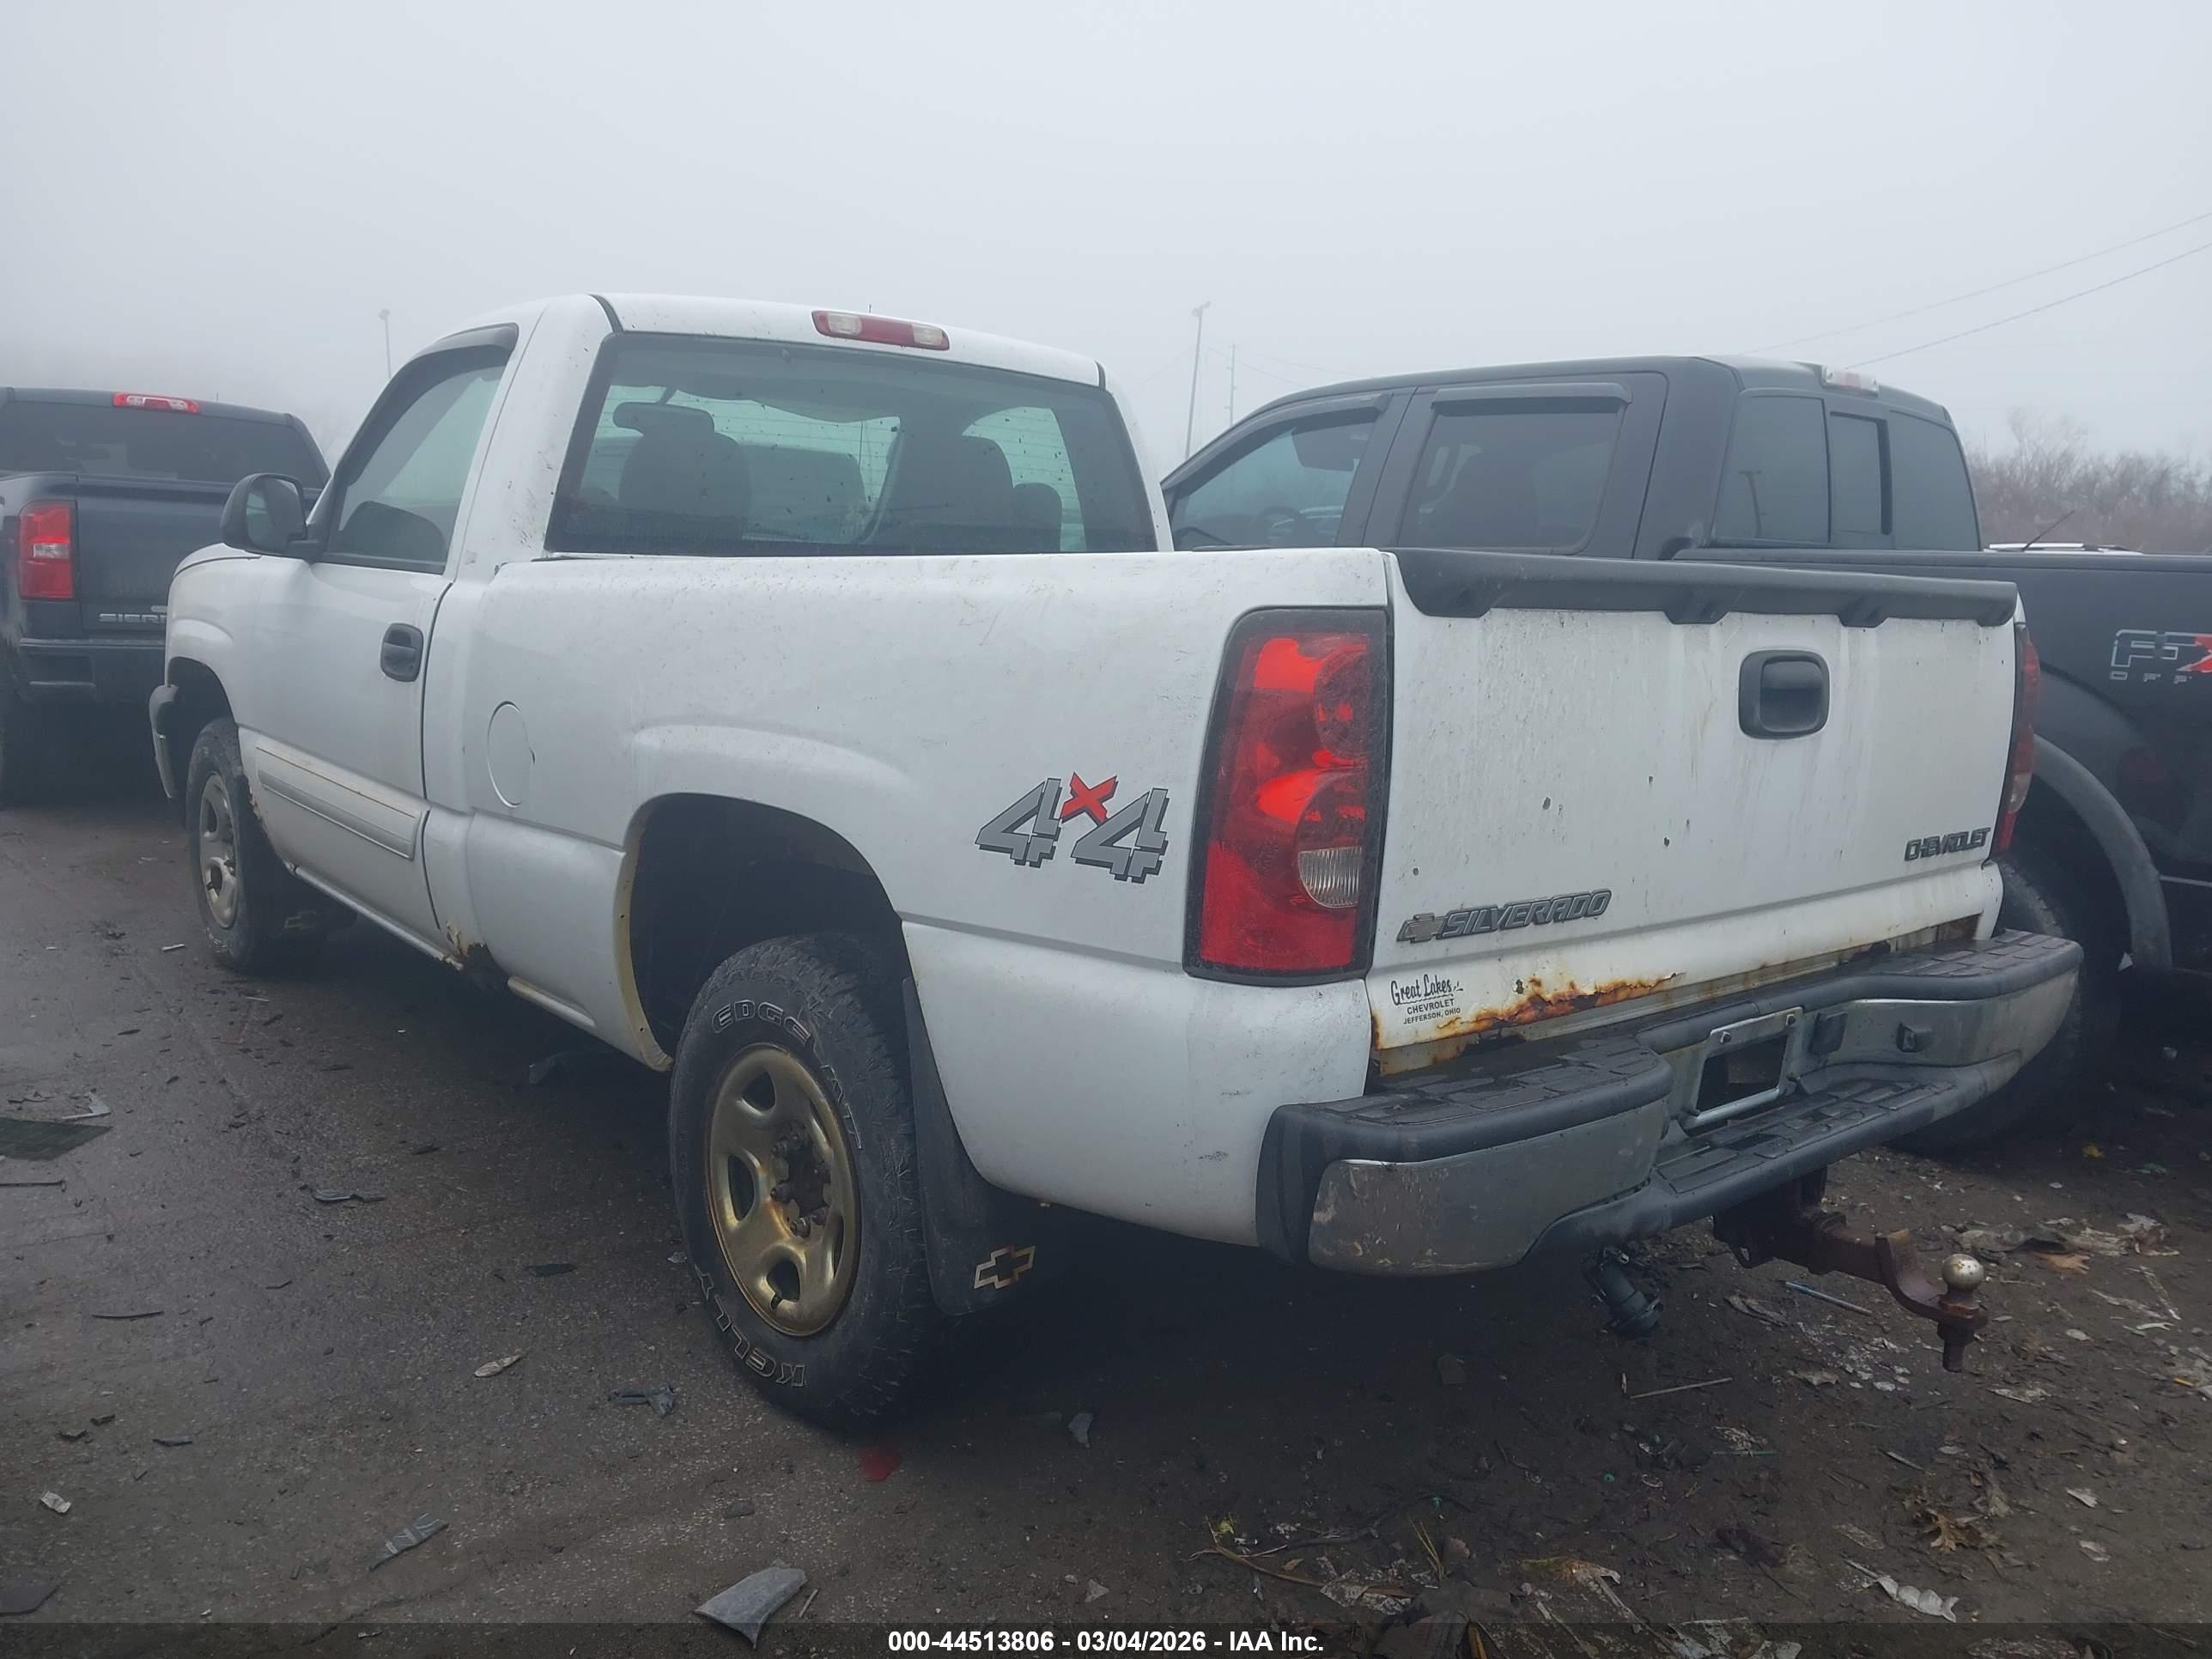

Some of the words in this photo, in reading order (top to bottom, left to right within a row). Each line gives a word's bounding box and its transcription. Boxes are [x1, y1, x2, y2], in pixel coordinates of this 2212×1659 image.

[1904, 827, 1991, 861] CHEVROLET
[1437, 888, 1613, 939] SILVERADO
[1390, 979, 1421, 1005] Great
[1424, 974, 1452, 999] Lakes
[712, 999, 811, 1045] EDGE
[1403, 1012, 1443, 1024] JEFFERSON,
[1445, 1007, 1461, 1017] OHIO
[1407, 999, 1455, 1015] CHEVROLET
[694, 1264, 805, 1387] KELLY
